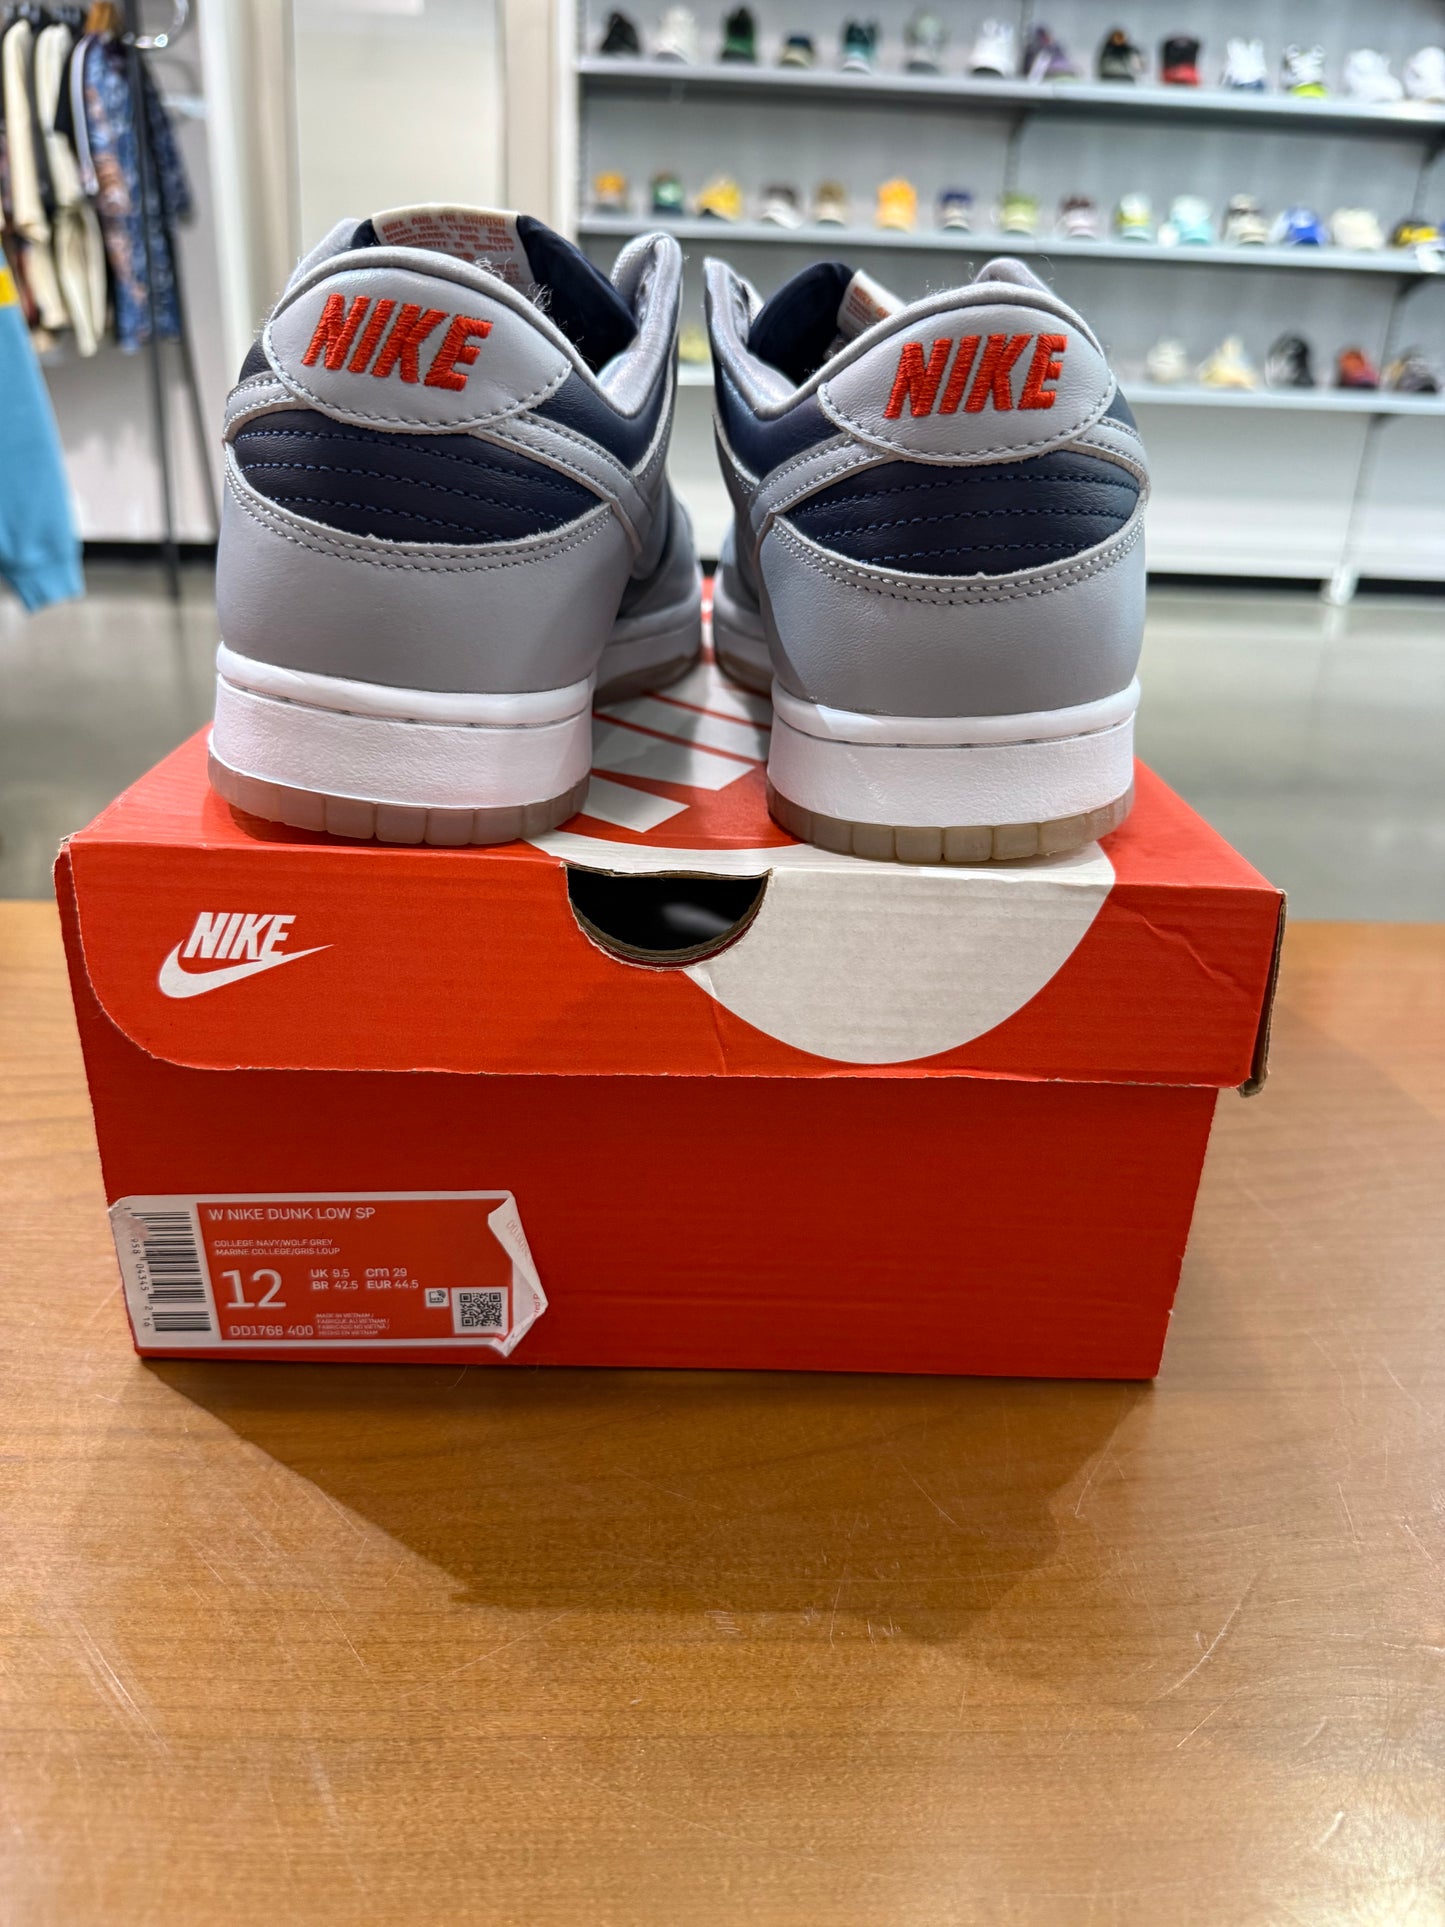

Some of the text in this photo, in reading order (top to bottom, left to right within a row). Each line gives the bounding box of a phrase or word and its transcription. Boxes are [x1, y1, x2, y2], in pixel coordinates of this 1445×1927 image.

[302, 293, 494, 392] NIKE
[883, 333, 1067, 419] NIKE
[183, 912, 296, 960] NIKE
[209, 1207, 376, 1221] W NIKE DUNK LOW SP
[256, 1239, 308, 1247] NAVY/WOLF
[251, 1248, 315, 1256] COLLEGE/GRIS
[316, 1247, 341, 1255] LOUP
[311, 1267, 408, 1278] UK 9.5 cm 29
[222, 1268, 287, 1308] 12
[312, 1279, 419, 1290] BR 42.5 EUR 44.5
[229, 1325, 314, 1337] DD1768 400
